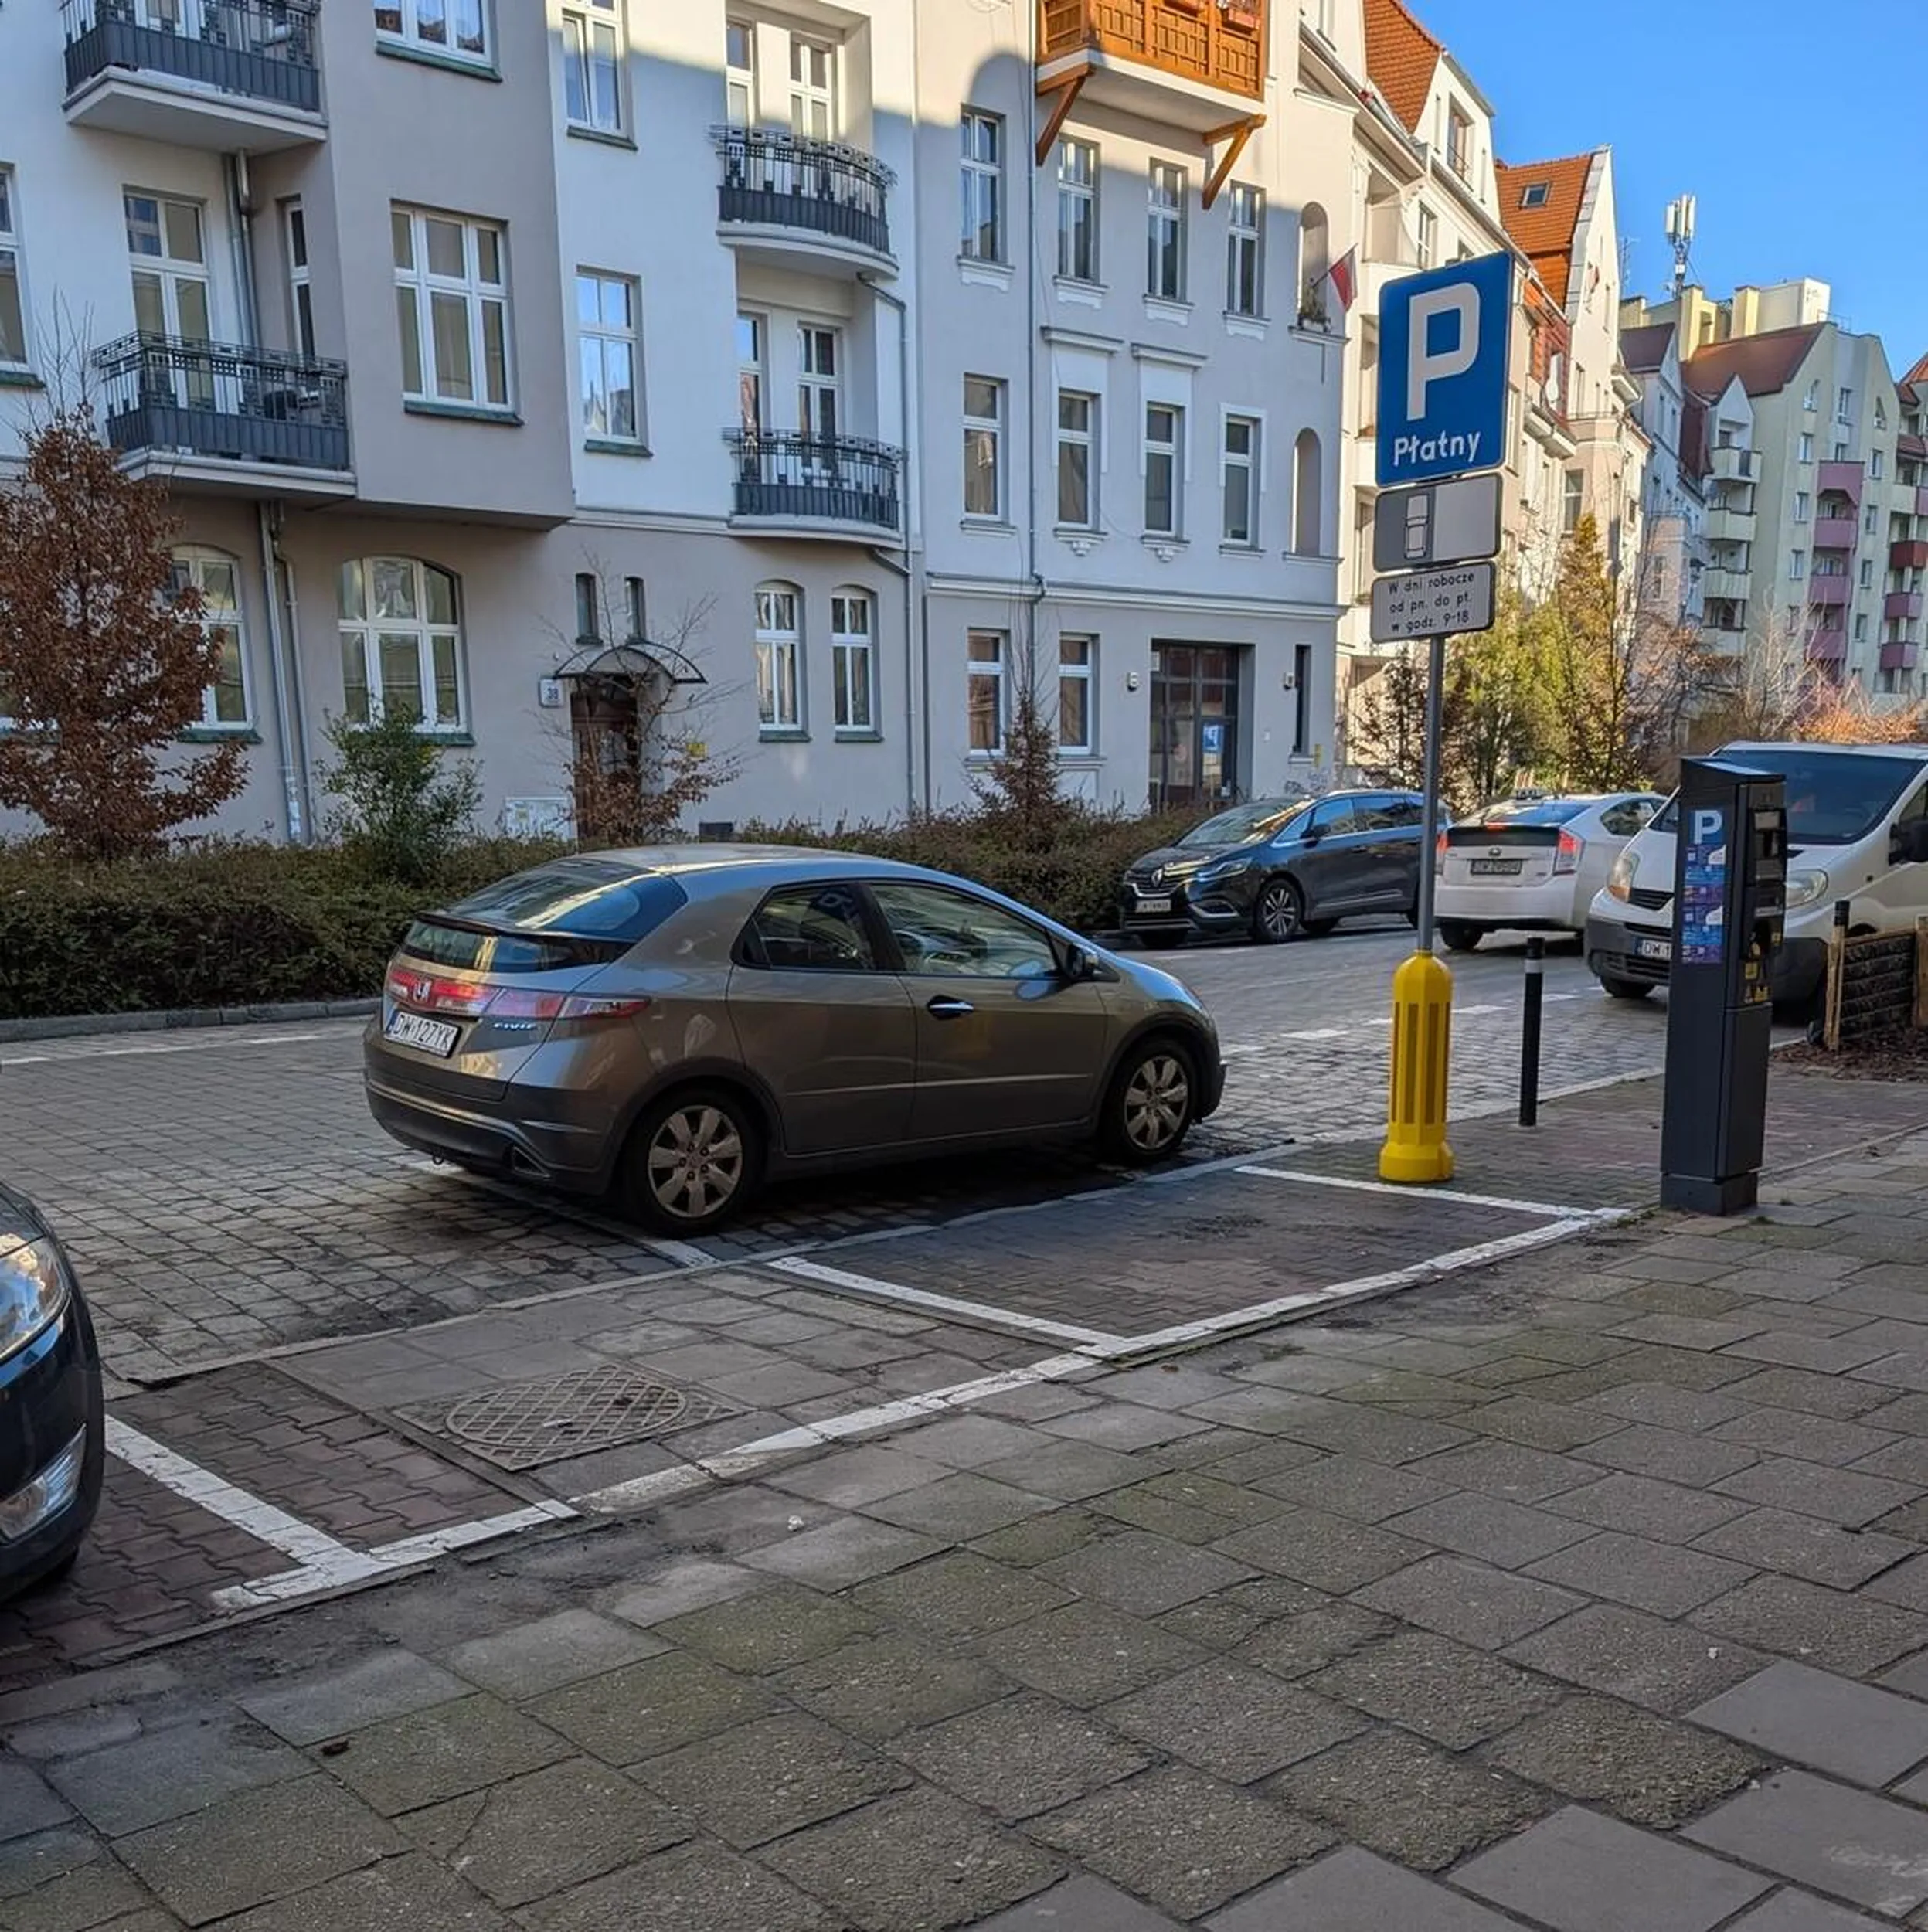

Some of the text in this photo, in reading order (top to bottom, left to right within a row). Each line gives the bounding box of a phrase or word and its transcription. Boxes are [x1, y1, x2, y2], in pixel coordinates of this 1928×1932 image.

[1407, 282, 1480, 420] P
[1393, 430, 1481, 468] Płatny
[1389, 573, 1474, 594] W dni robocze
[1389, 600, 1404, 613] od
[1434, 594, 1450, 607] do
[1694, 811, 1722, 844] P
